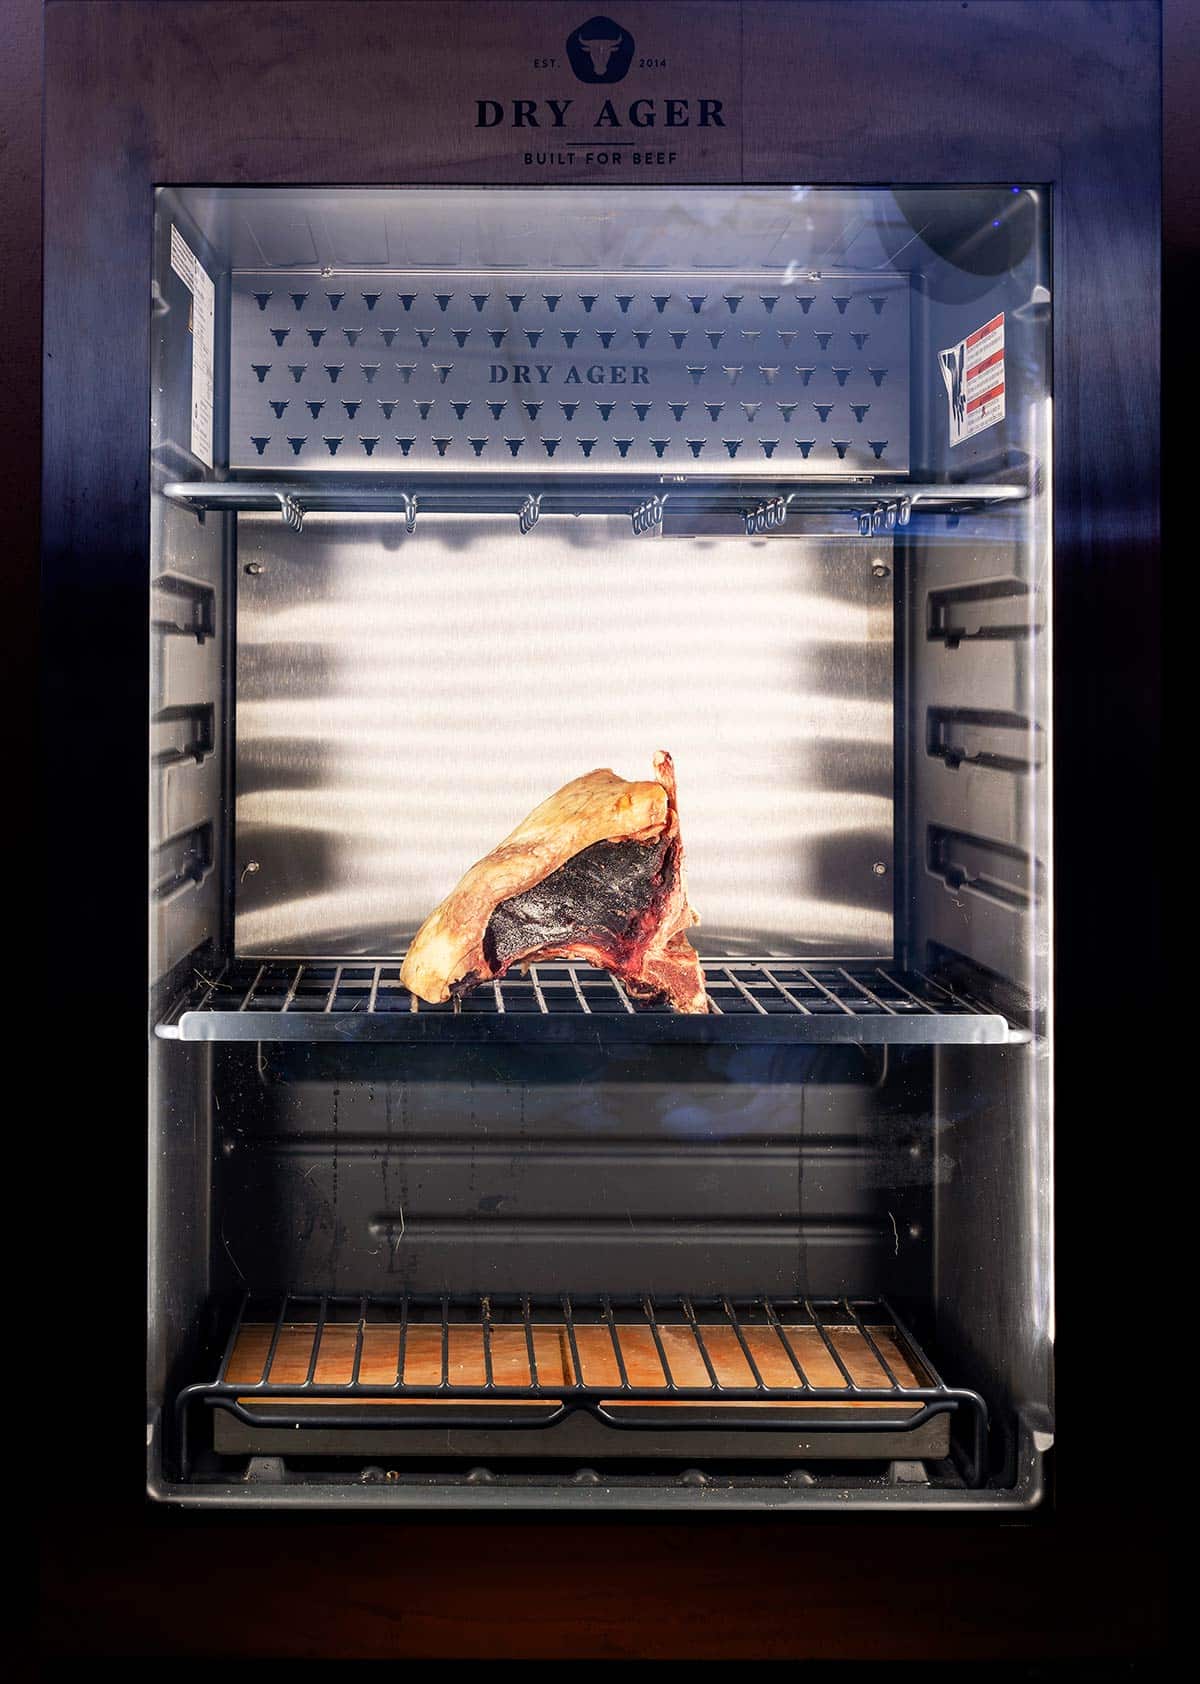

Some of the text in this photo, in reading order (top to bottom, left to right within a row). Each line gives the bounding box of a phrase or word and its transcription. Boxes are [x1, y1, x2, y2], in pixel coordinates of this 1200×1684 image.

[534, 58, 667, 68] EST. 2014
[475, 99, 726, 128] DRY AGER
[524, 153, 677, 165] BUILT FOR BEEF
[488, 365, 650, 384] DRY AGER
